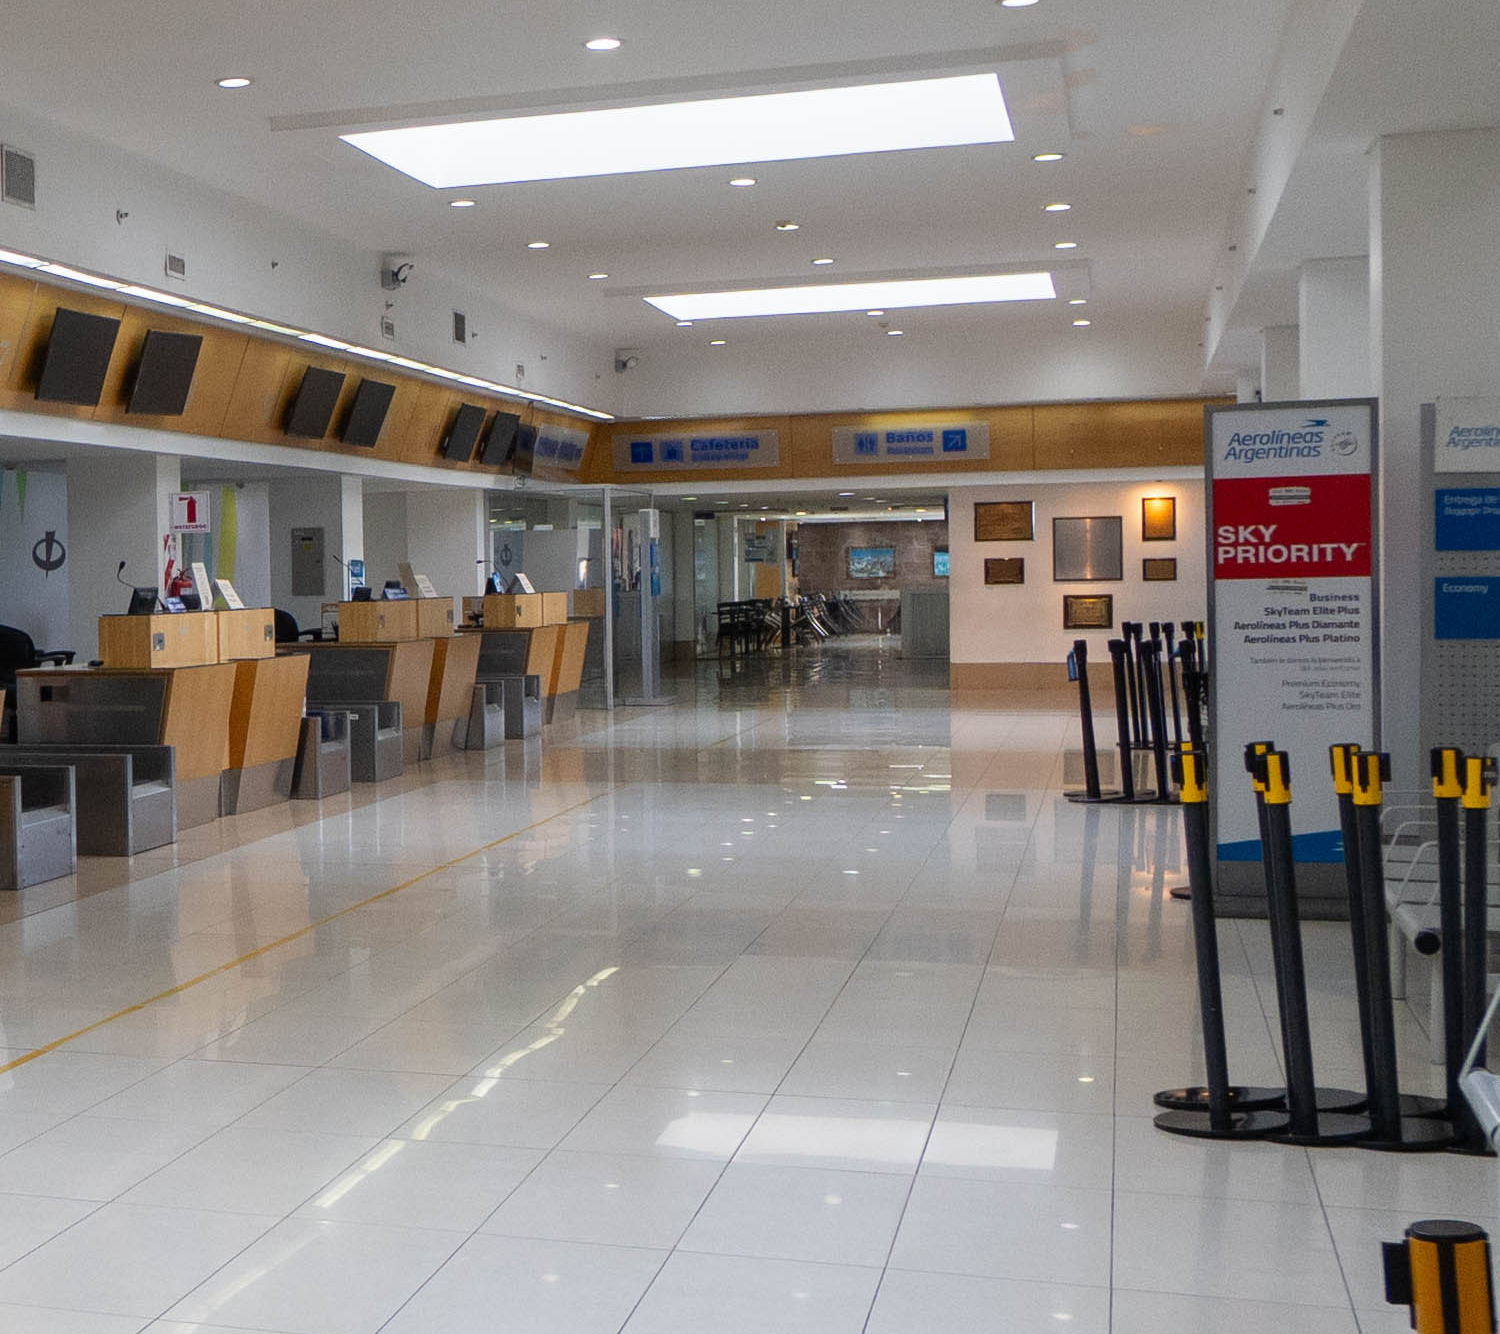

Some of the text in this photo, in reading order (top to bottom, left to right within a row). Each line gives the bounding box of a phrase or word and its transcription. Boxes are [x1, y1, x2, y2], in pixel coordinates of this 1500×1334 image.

[1228, 430, 1324, 447] Aerolíneas
[1224, 444, 1321, 464] Argentinas
[1217, 525, 1278, 543] SKY
[1217, 543, 1359, 564] PRIORITY
[1442, 583, 1489, 594] Economy
[1309, 593, 1360, 602] Business
[1264, 605, 1360, 617] SkyTeam Elite Plus
[1234, 619, 1360, 630] Aerolíneas Plus Diamante
[1243, 633, 1360, 644] Aerolíneas Plus Platino
[1322, 679, 1360, 689] Economy
[1341, 690, 1361, 699] Elite
